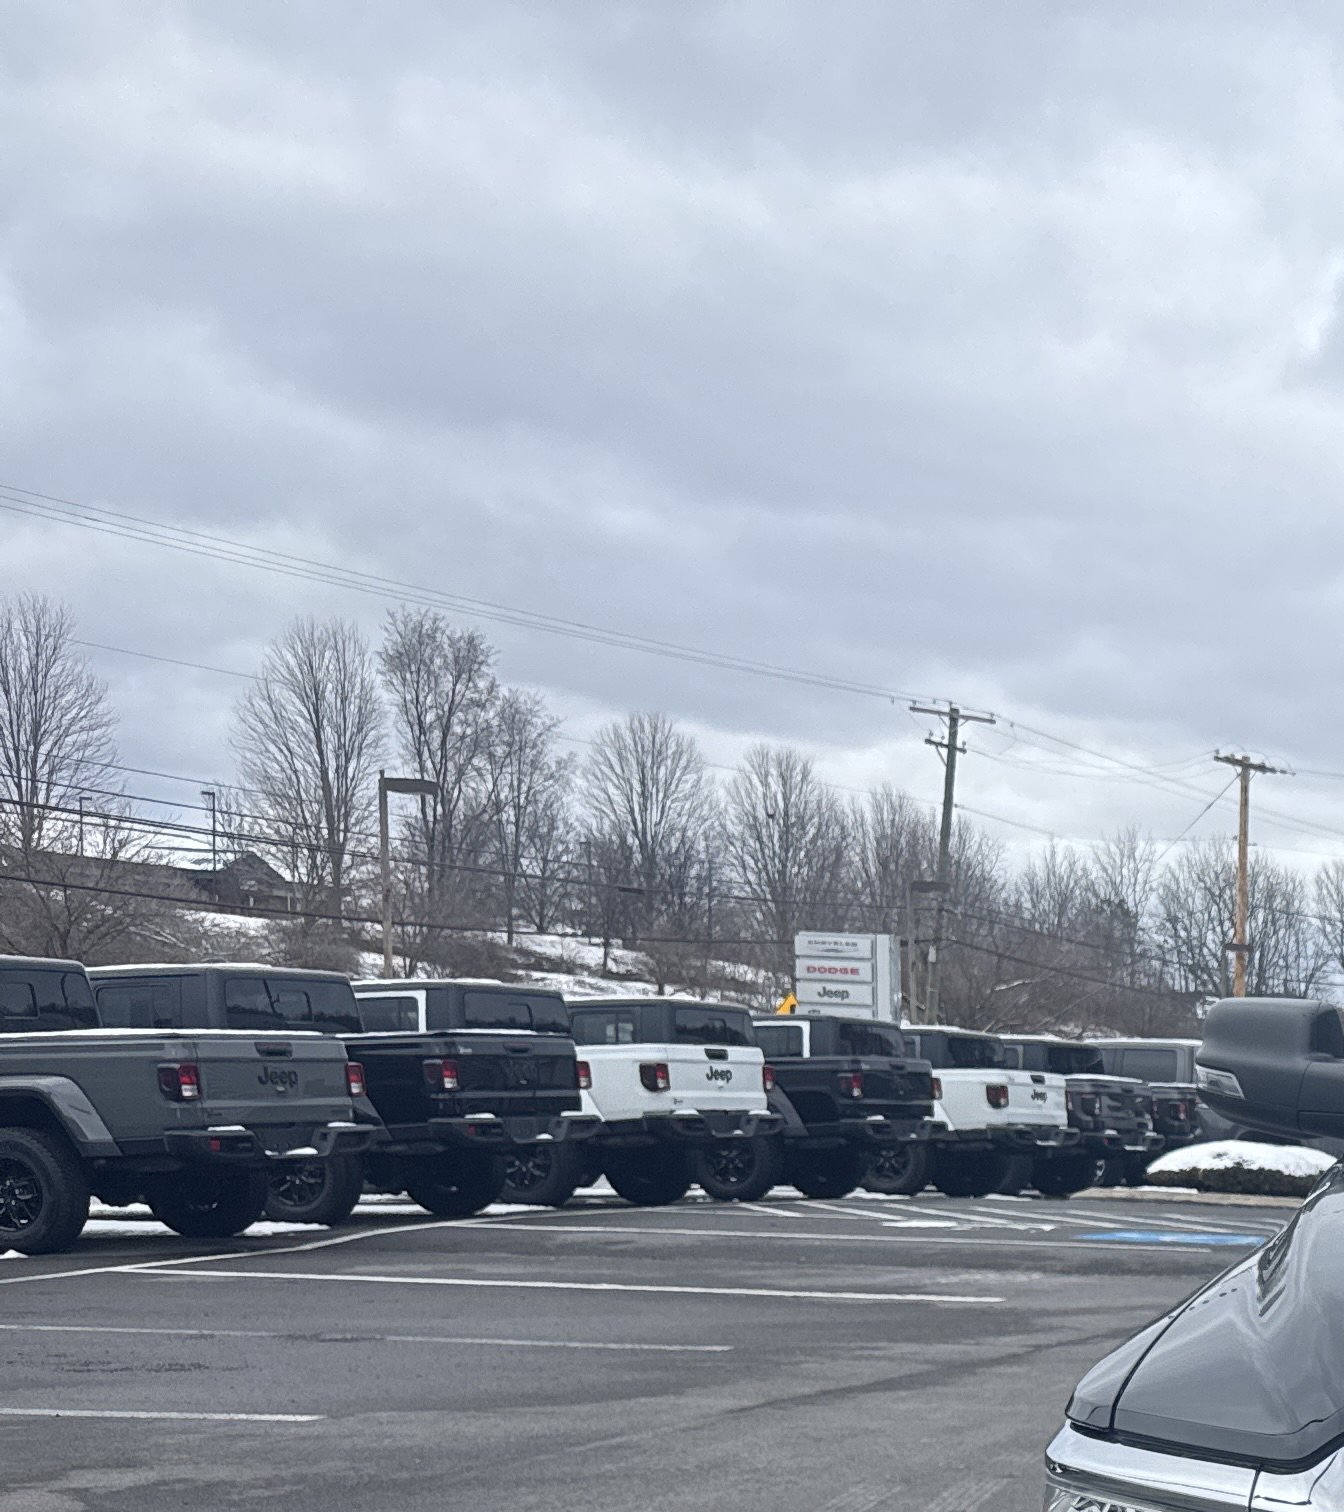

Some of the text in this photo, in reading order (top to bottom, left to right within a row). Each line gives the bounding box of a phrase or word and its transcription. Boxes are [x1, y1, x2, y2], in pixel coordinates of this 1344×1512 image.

[807, 966, 860, 975] DODGE
[817, 986, 850, 1001] Jeep
[257, 1065, 299, 1088] Jeep
[706, 1065, 732, 1084] Jeep
